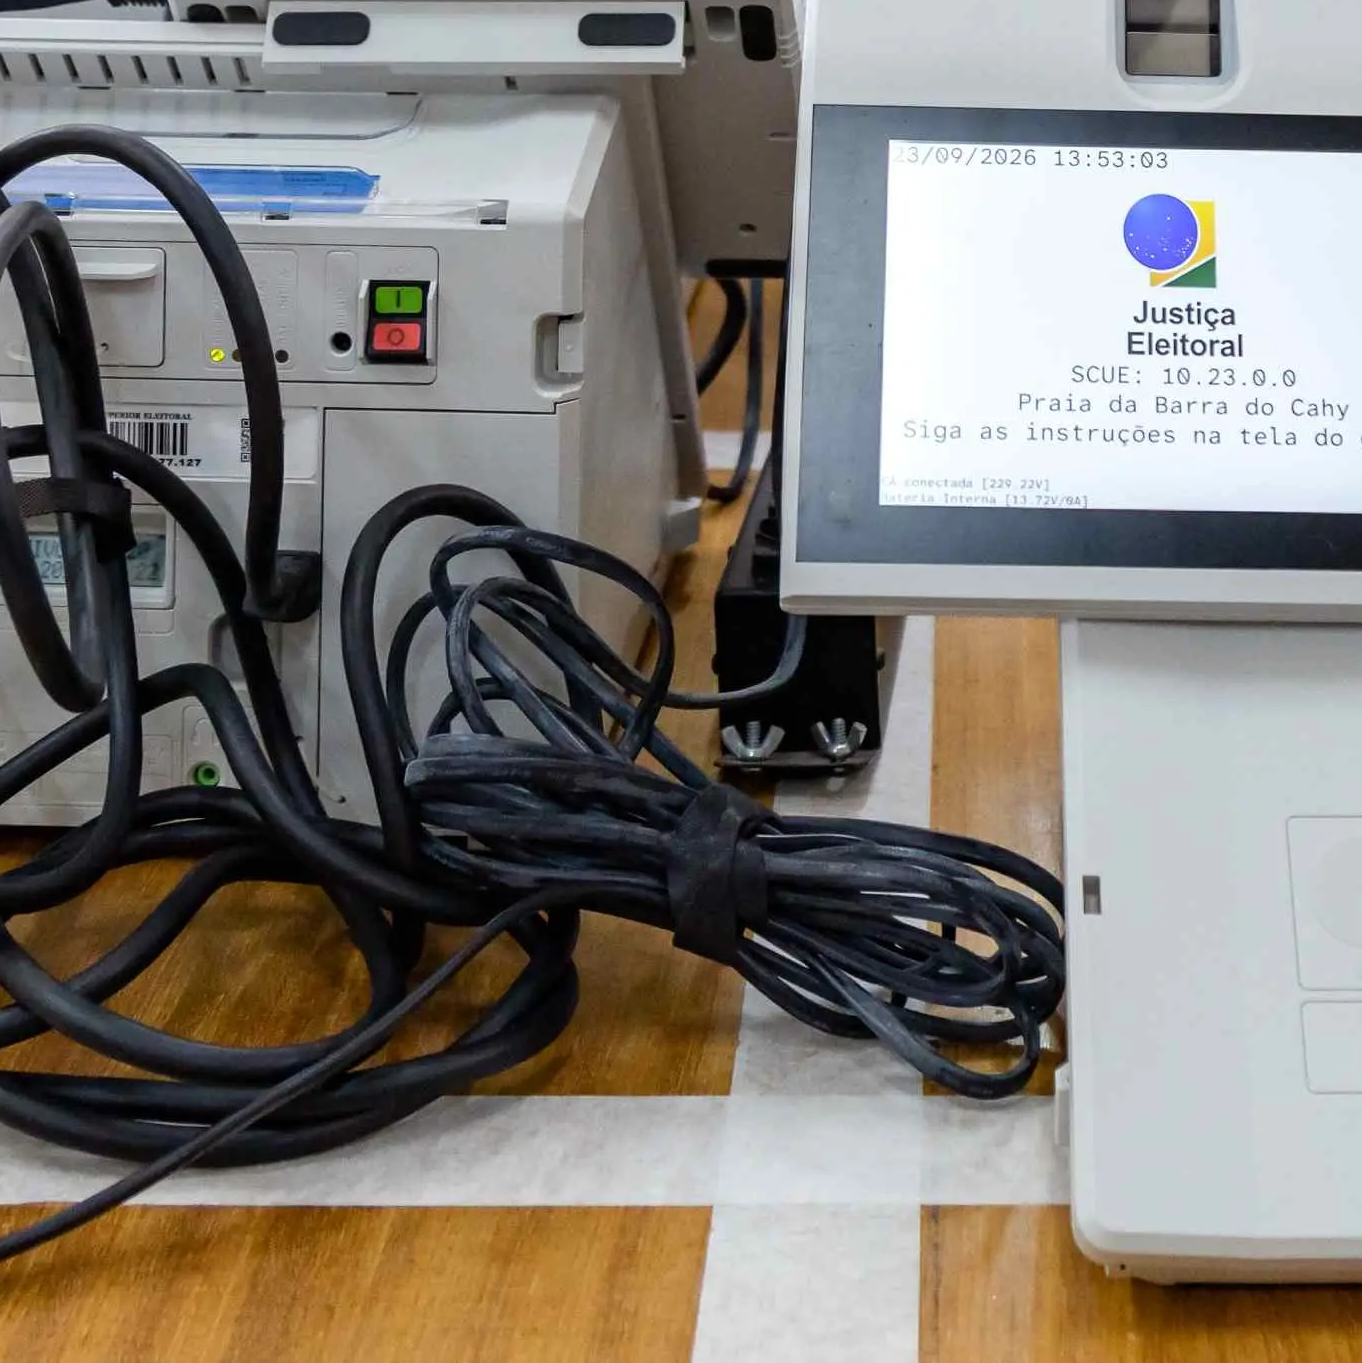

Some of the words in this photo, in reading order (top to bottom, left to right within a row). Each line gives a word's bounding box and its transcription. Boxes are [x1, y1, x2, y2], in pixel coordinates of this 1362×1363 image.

[892, 146, 1037, 167] 23/09/2026
[1054, 149, 1169, 169] 13:53:03
[1133, 300, 1236, 331] Justiça
[1127, 331, 1243, 357] Eleitoral
[1071, 365, 1142, 385] SCUE:
[1163, 367, 1296, 387] 10.23.0.0
[109, 412, 141, 420] PERIOR
[1019, 393, 1092, 413] Praia
[1109, 394, 1137, 414] da
[1155, 396, 1228, 415] Barra
[1245, 397, 1274, 416] do
[1291, 398, 1350, 420] Cahy
[903, 419, 962, 443] Siga
[980, 424, 1008, 440] as
[1026, 421, 1175, 446] instruções
[1193, 429, 1221, 445] na
[1241, 426, 1297, 445] tela
[1314, 428, 1343, 447] do
[159, 458, 202, 467] 77.127
[883, 492, 936, 504] ateria
